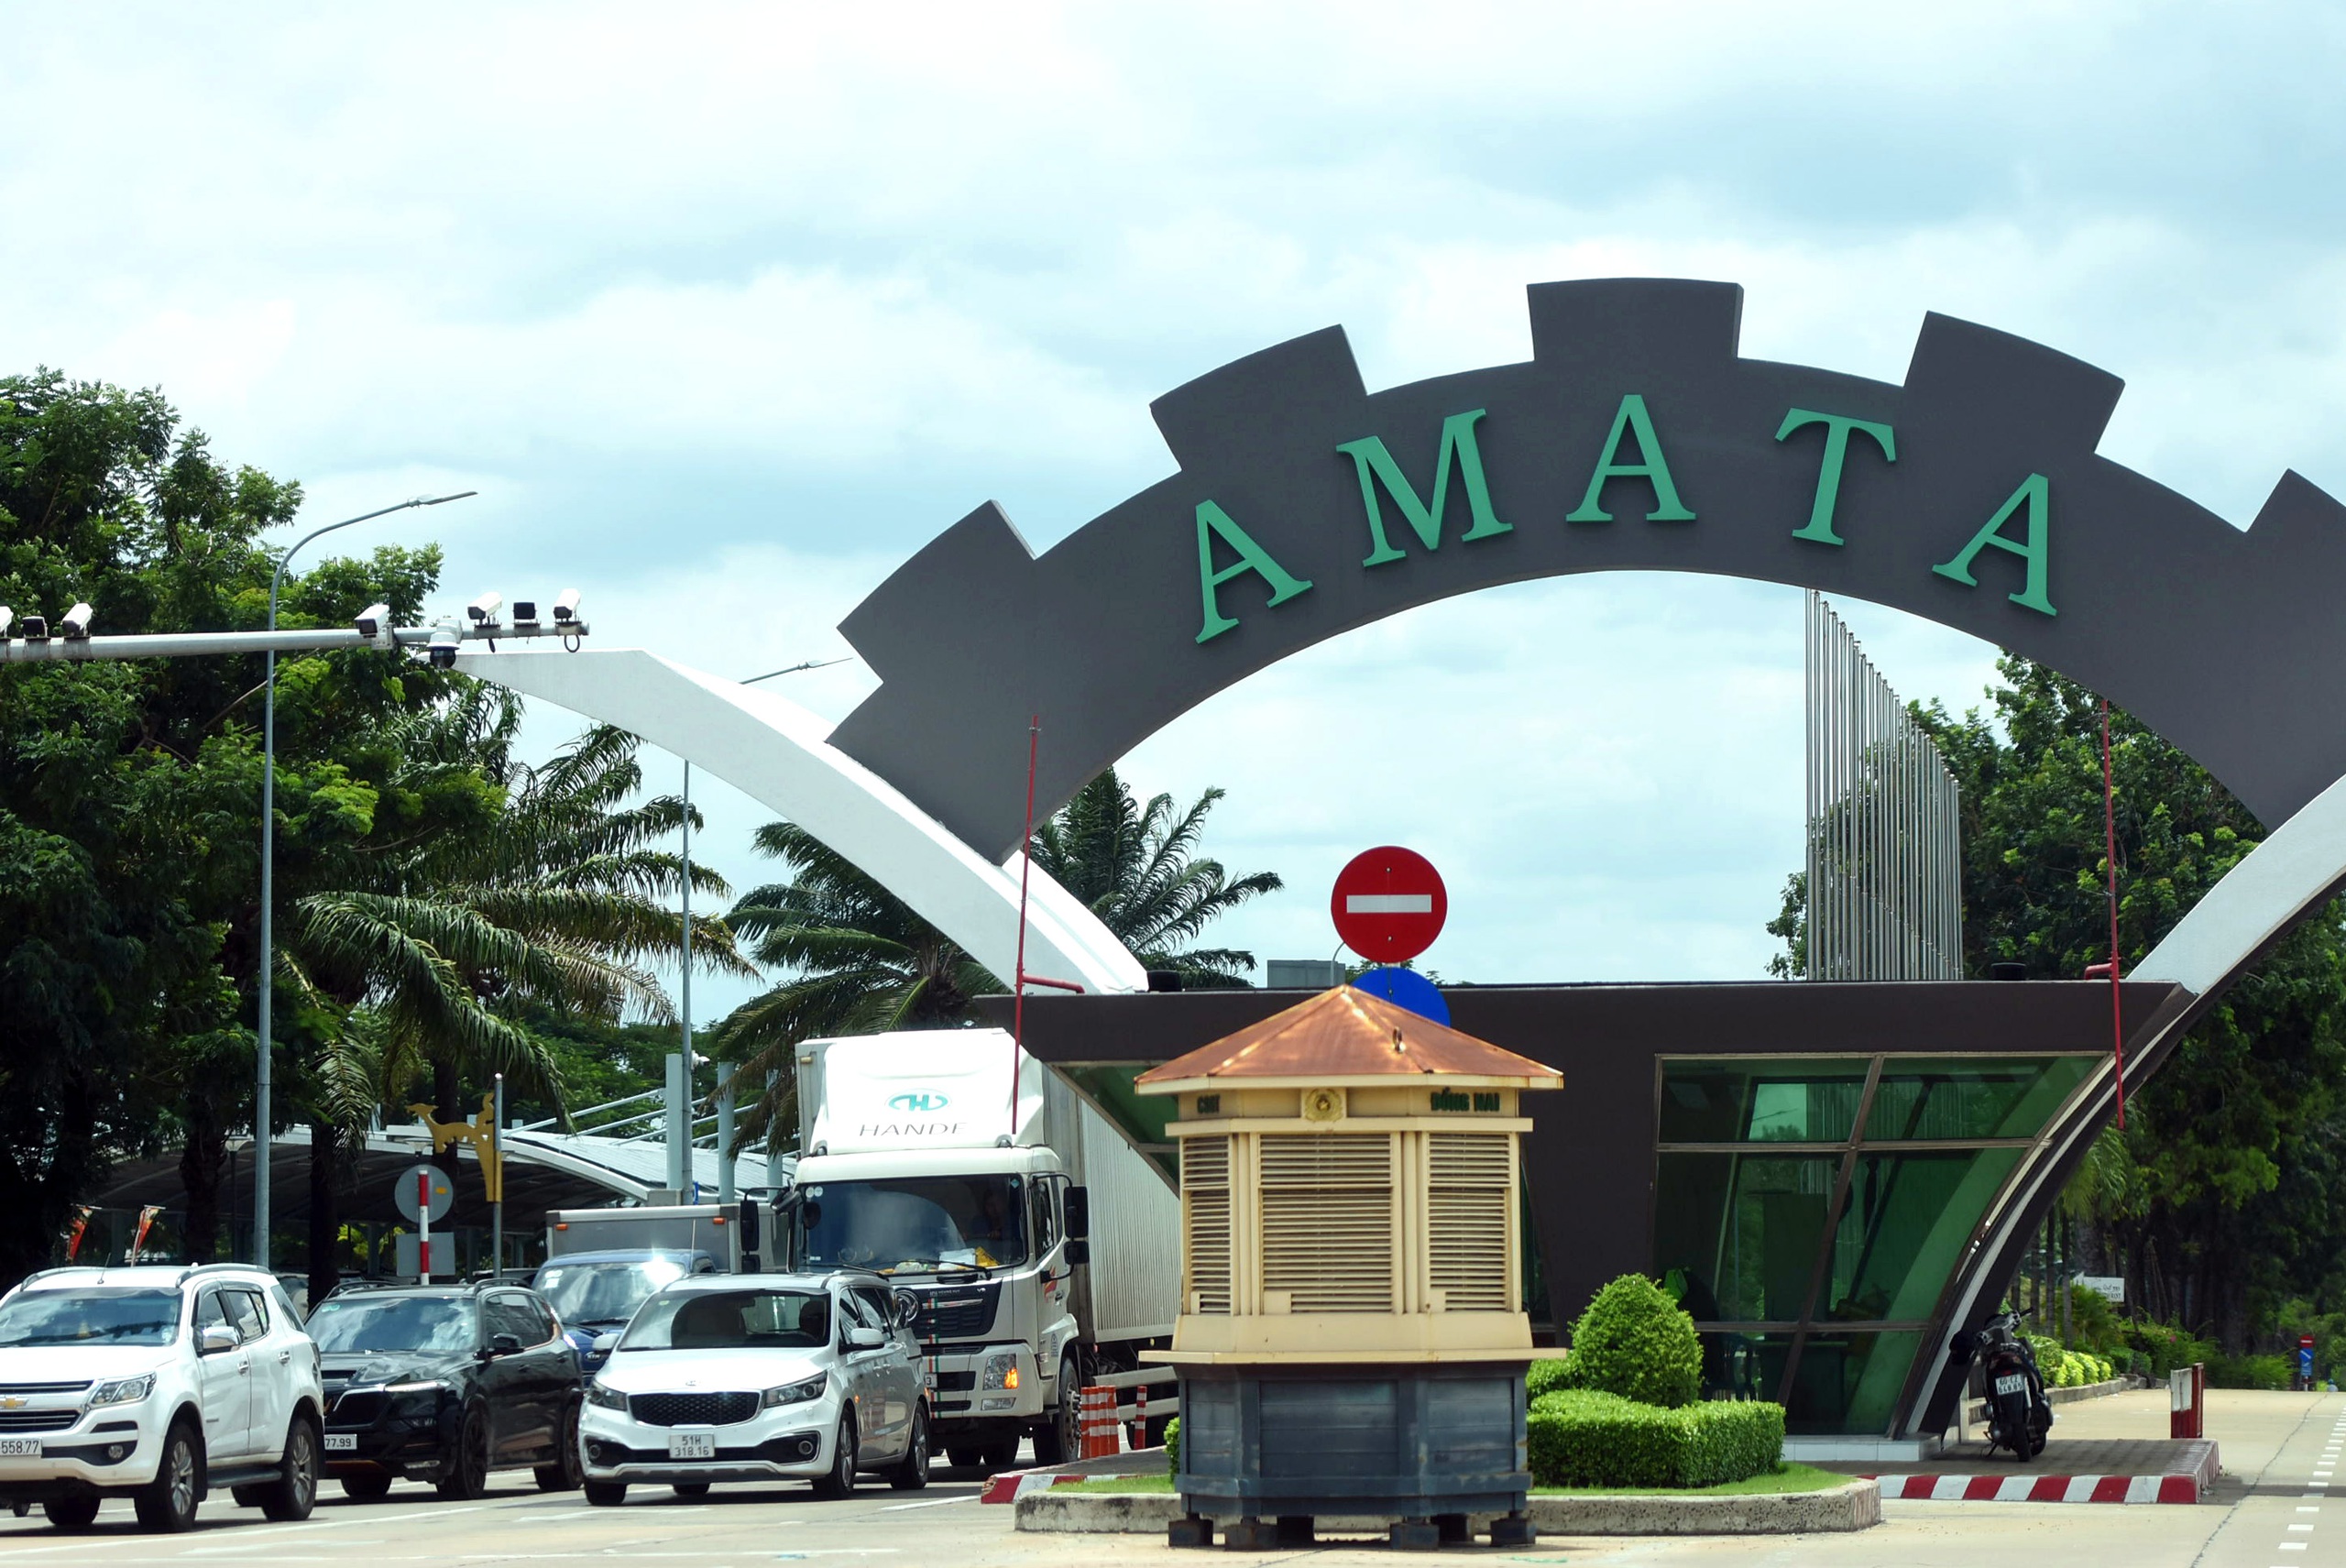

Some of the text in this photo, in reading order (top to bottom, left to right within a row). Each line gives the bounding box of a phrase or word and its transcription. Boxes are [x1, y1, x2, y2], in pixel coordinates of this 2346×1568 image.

[1195, 394, 2057, 645] AMATA
[1474, 1092, 1500, 1112] NAI
[324, 1438, 352, 1448] 77.99
[682, 1435, 701, 1445] 51H
[1, 1440, 39, 1454] 558.77
[674, 1446, 709, 1457] 318.16
